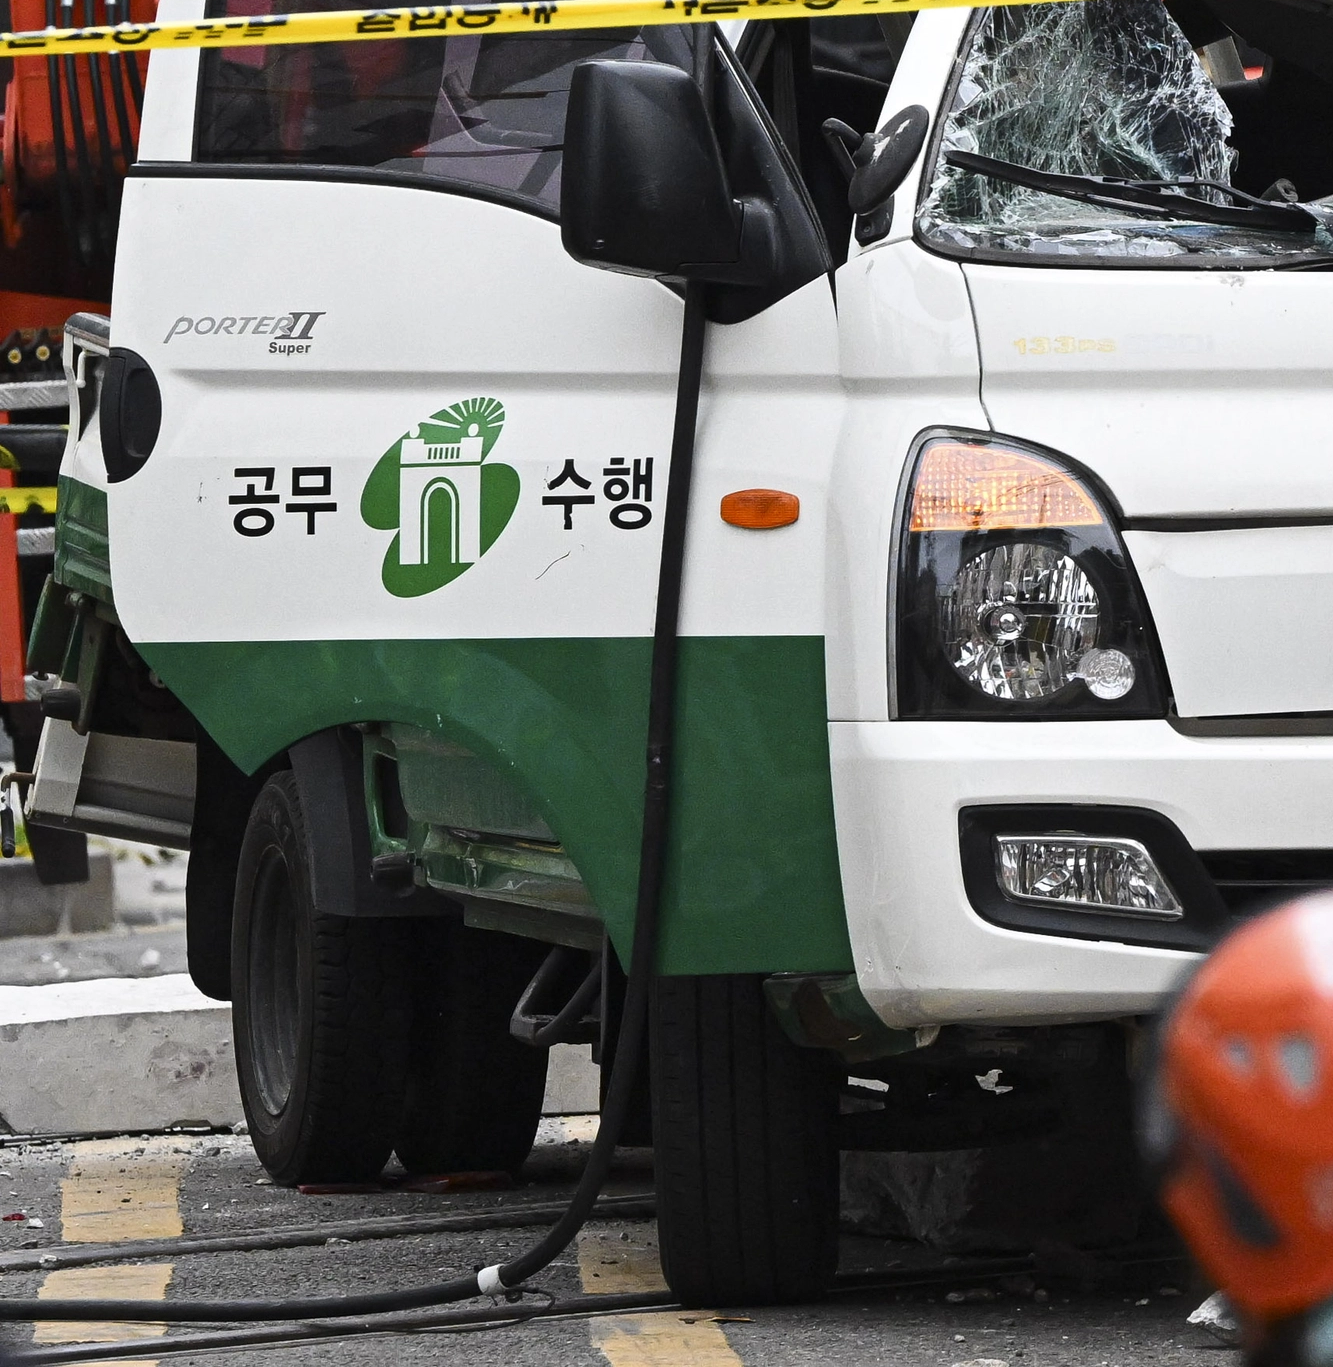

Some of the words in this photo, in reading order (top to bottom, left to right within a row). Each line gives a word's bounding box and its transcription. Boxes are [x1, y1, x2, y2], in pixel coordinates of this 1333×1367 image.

[268, 342, 312, 357] Super
[228, 466, 337, 537] 공무
[542, 456, 654, 531] 수행
